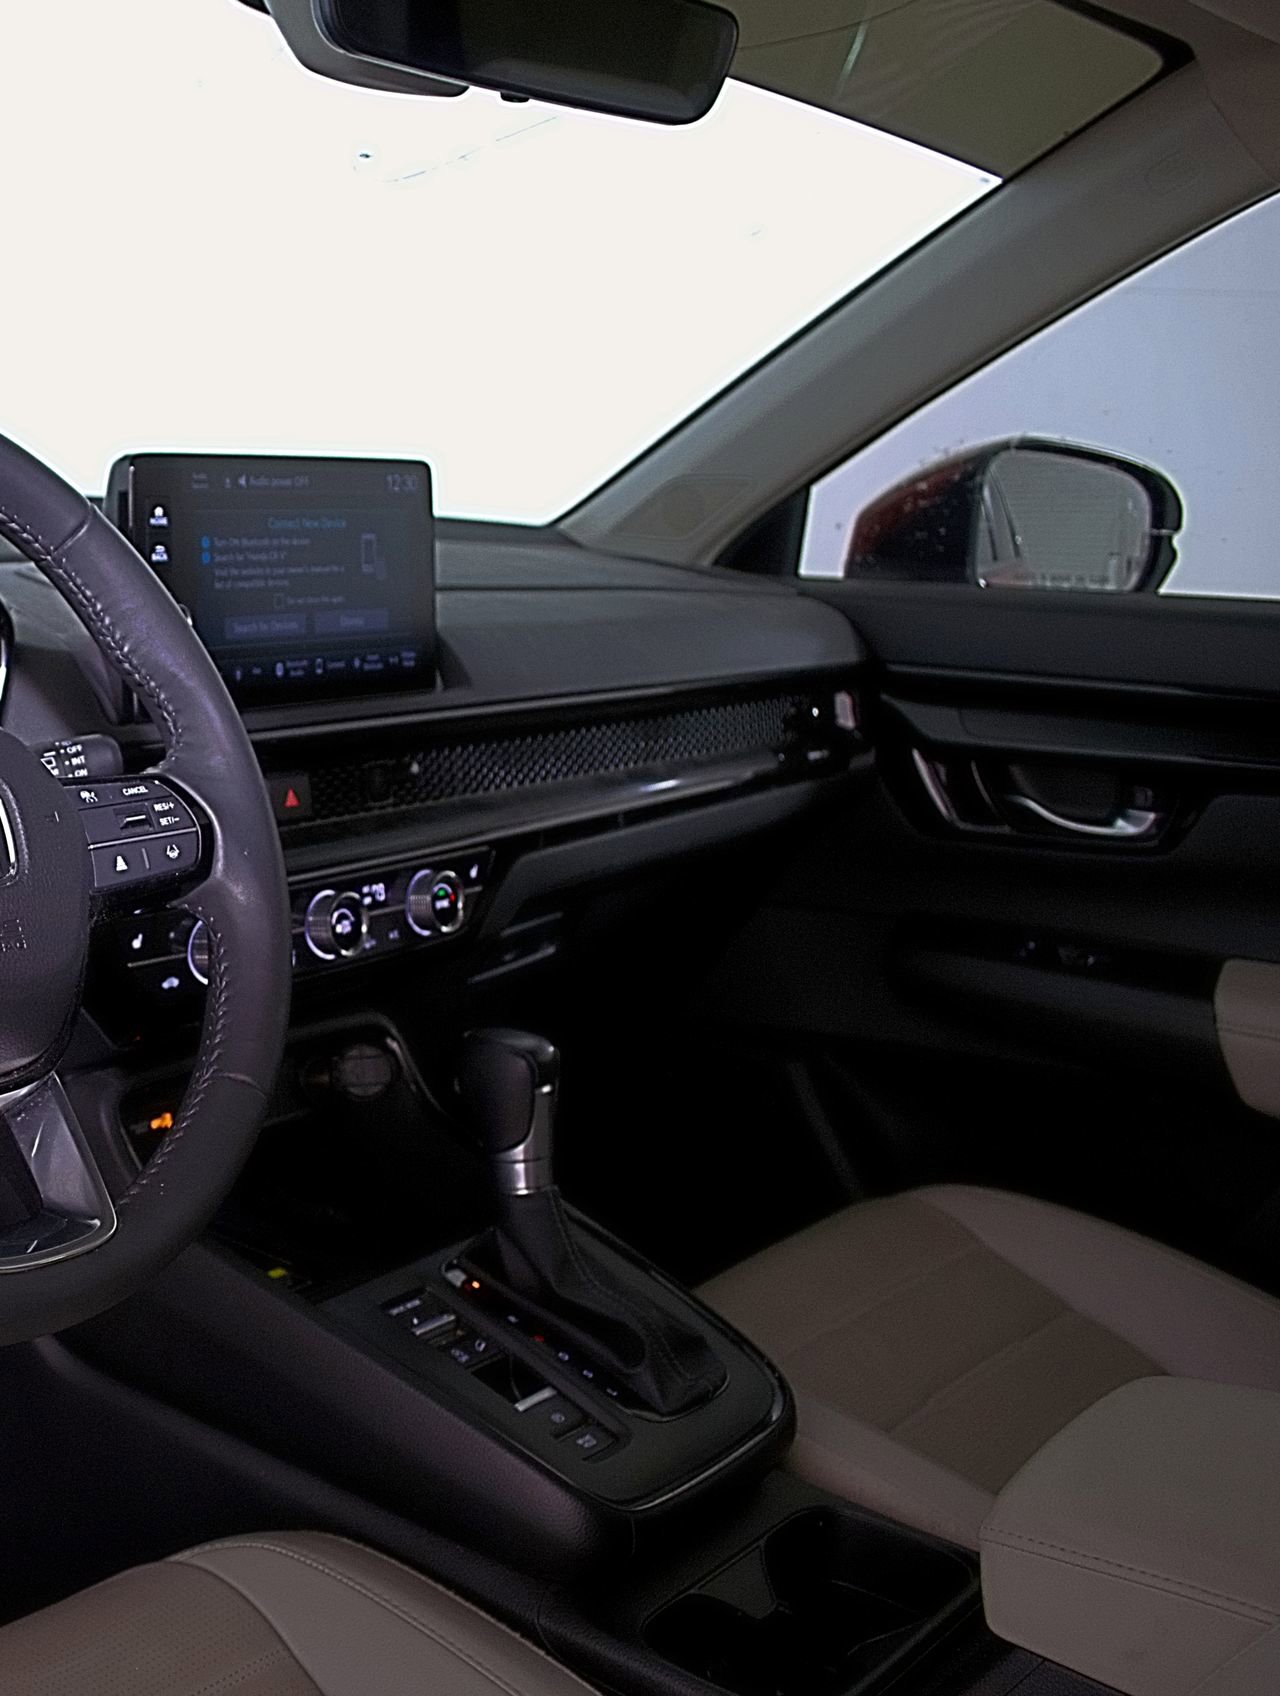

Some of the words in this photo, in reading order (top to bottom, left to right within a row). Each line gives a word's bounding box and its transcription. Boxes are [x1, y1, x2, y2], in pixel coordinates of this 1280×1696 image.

[66, 744, 83, 754] OFF
[70, 755, 86, 766] INT
[74, 768, 88, 777] ON
[122, 785, 149, 797] CANCEL
